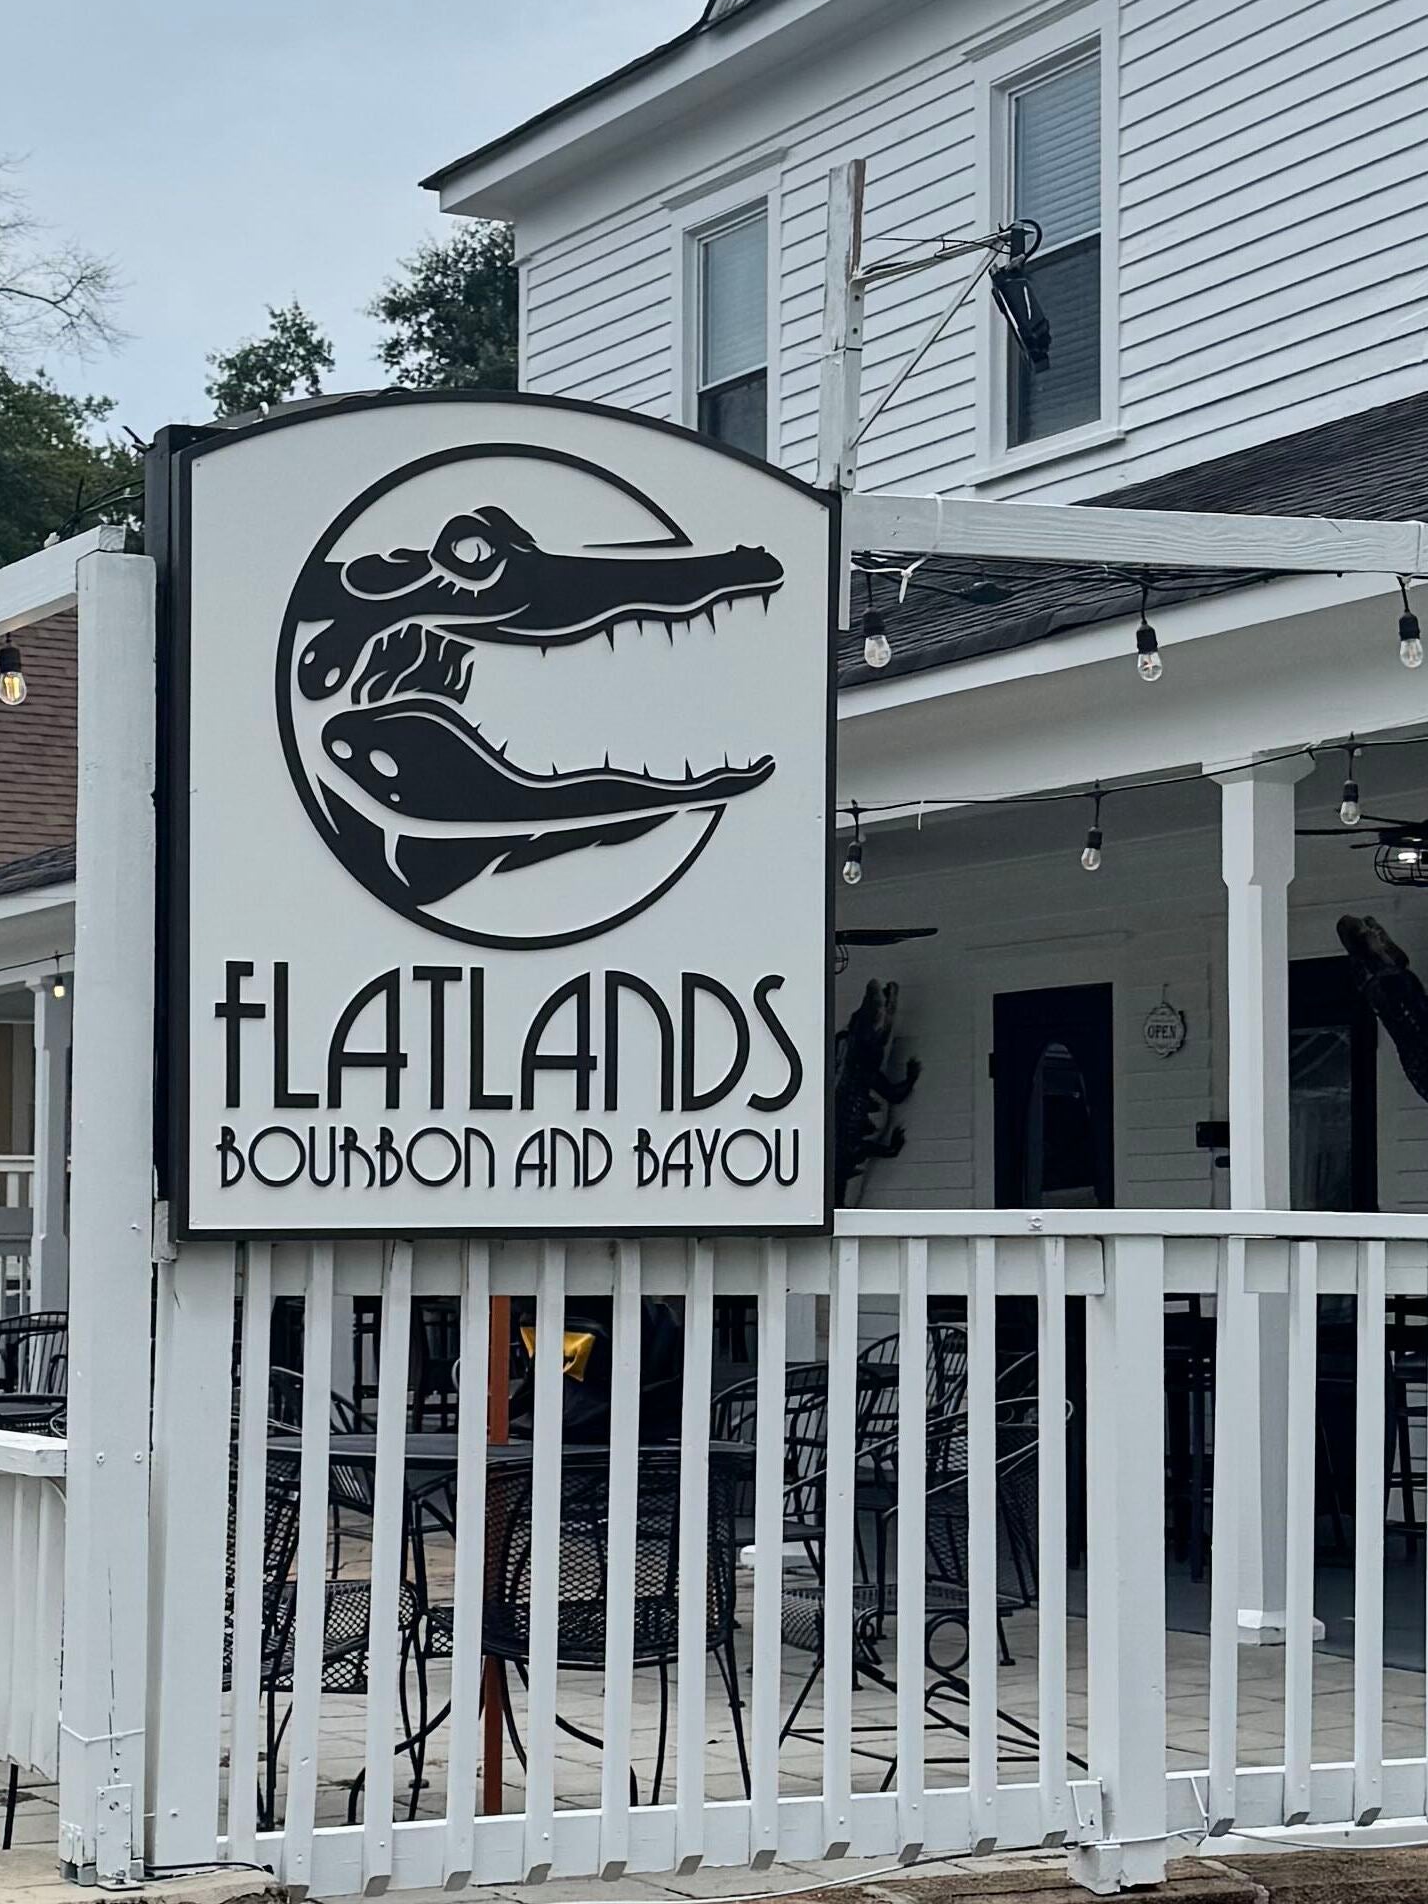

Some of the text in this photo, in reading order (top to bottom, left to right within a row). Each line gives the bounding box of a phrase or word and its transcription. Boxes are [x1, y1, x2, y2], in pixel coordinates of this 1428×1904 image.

[215, 960, 803, 1113] FLATLANDS
[1147, 1024, 1177, 1040] OPEN
[215, 1125, 800, 1188] BOURBON AND BAYOU
